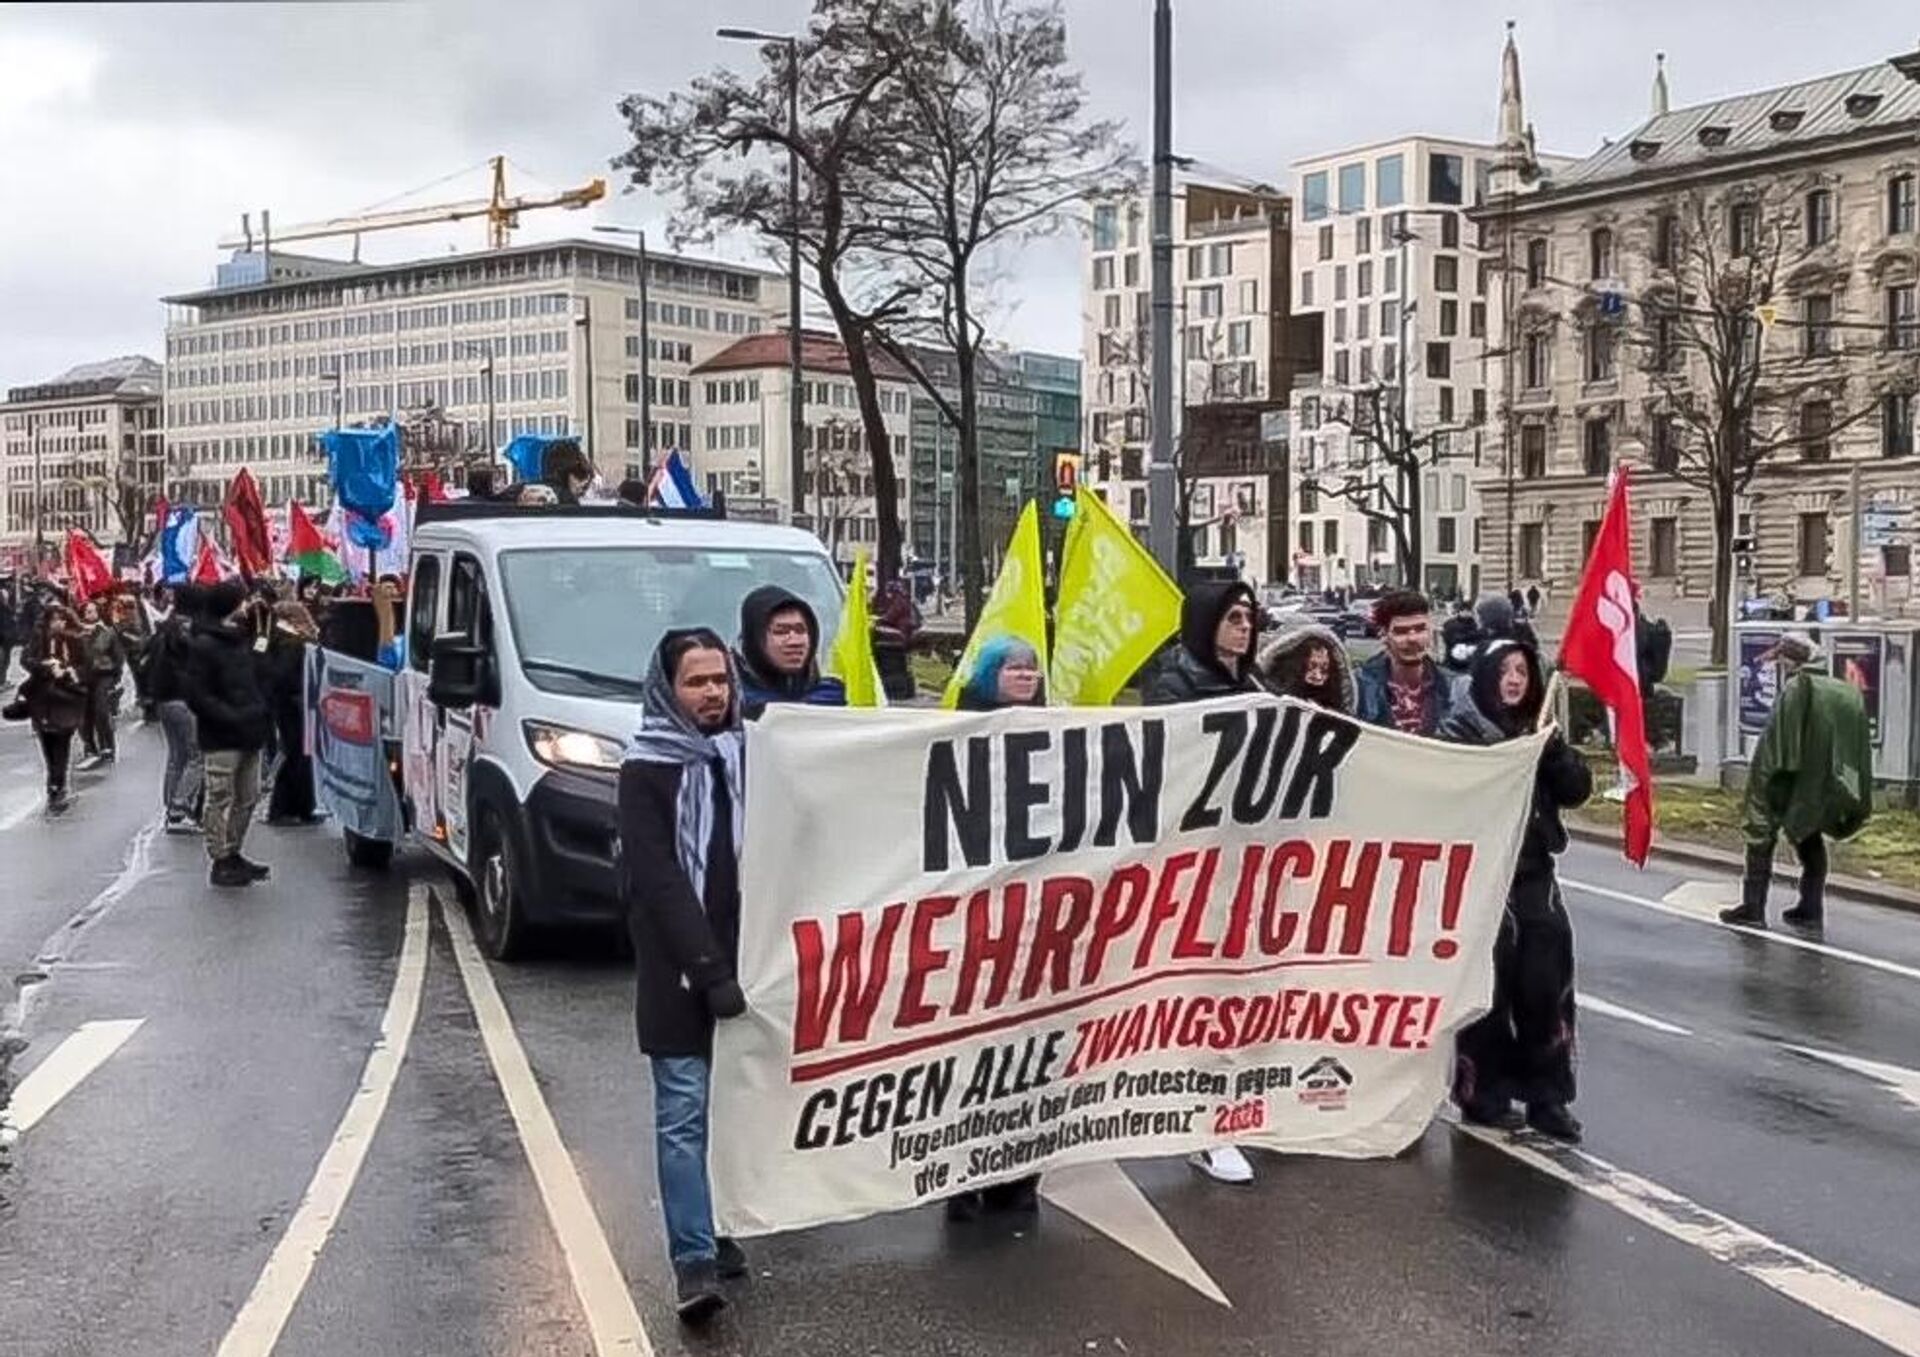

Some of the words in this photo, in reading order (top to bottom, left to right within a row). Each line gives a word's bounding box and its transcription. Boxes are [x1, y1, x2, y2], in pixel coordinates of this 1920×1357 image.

[922, 717, 1165, 873] NEIN
[1180, 706, 1362, 832] ZUR
[792, 839, 1474, 1054] WEHRPFLICHT!
[794, 1056, 957, 1150] GEGEN
[959, 1031, 1064, 1108] ALLE
[1062, 988, 1443, 1078] ZWANGSDIENSTE!
[1113, 1067, 1227, 1099] Protesten
[1235, 1065, 1293, 1099] gegen
[914, 1162, 950, 1196] die
